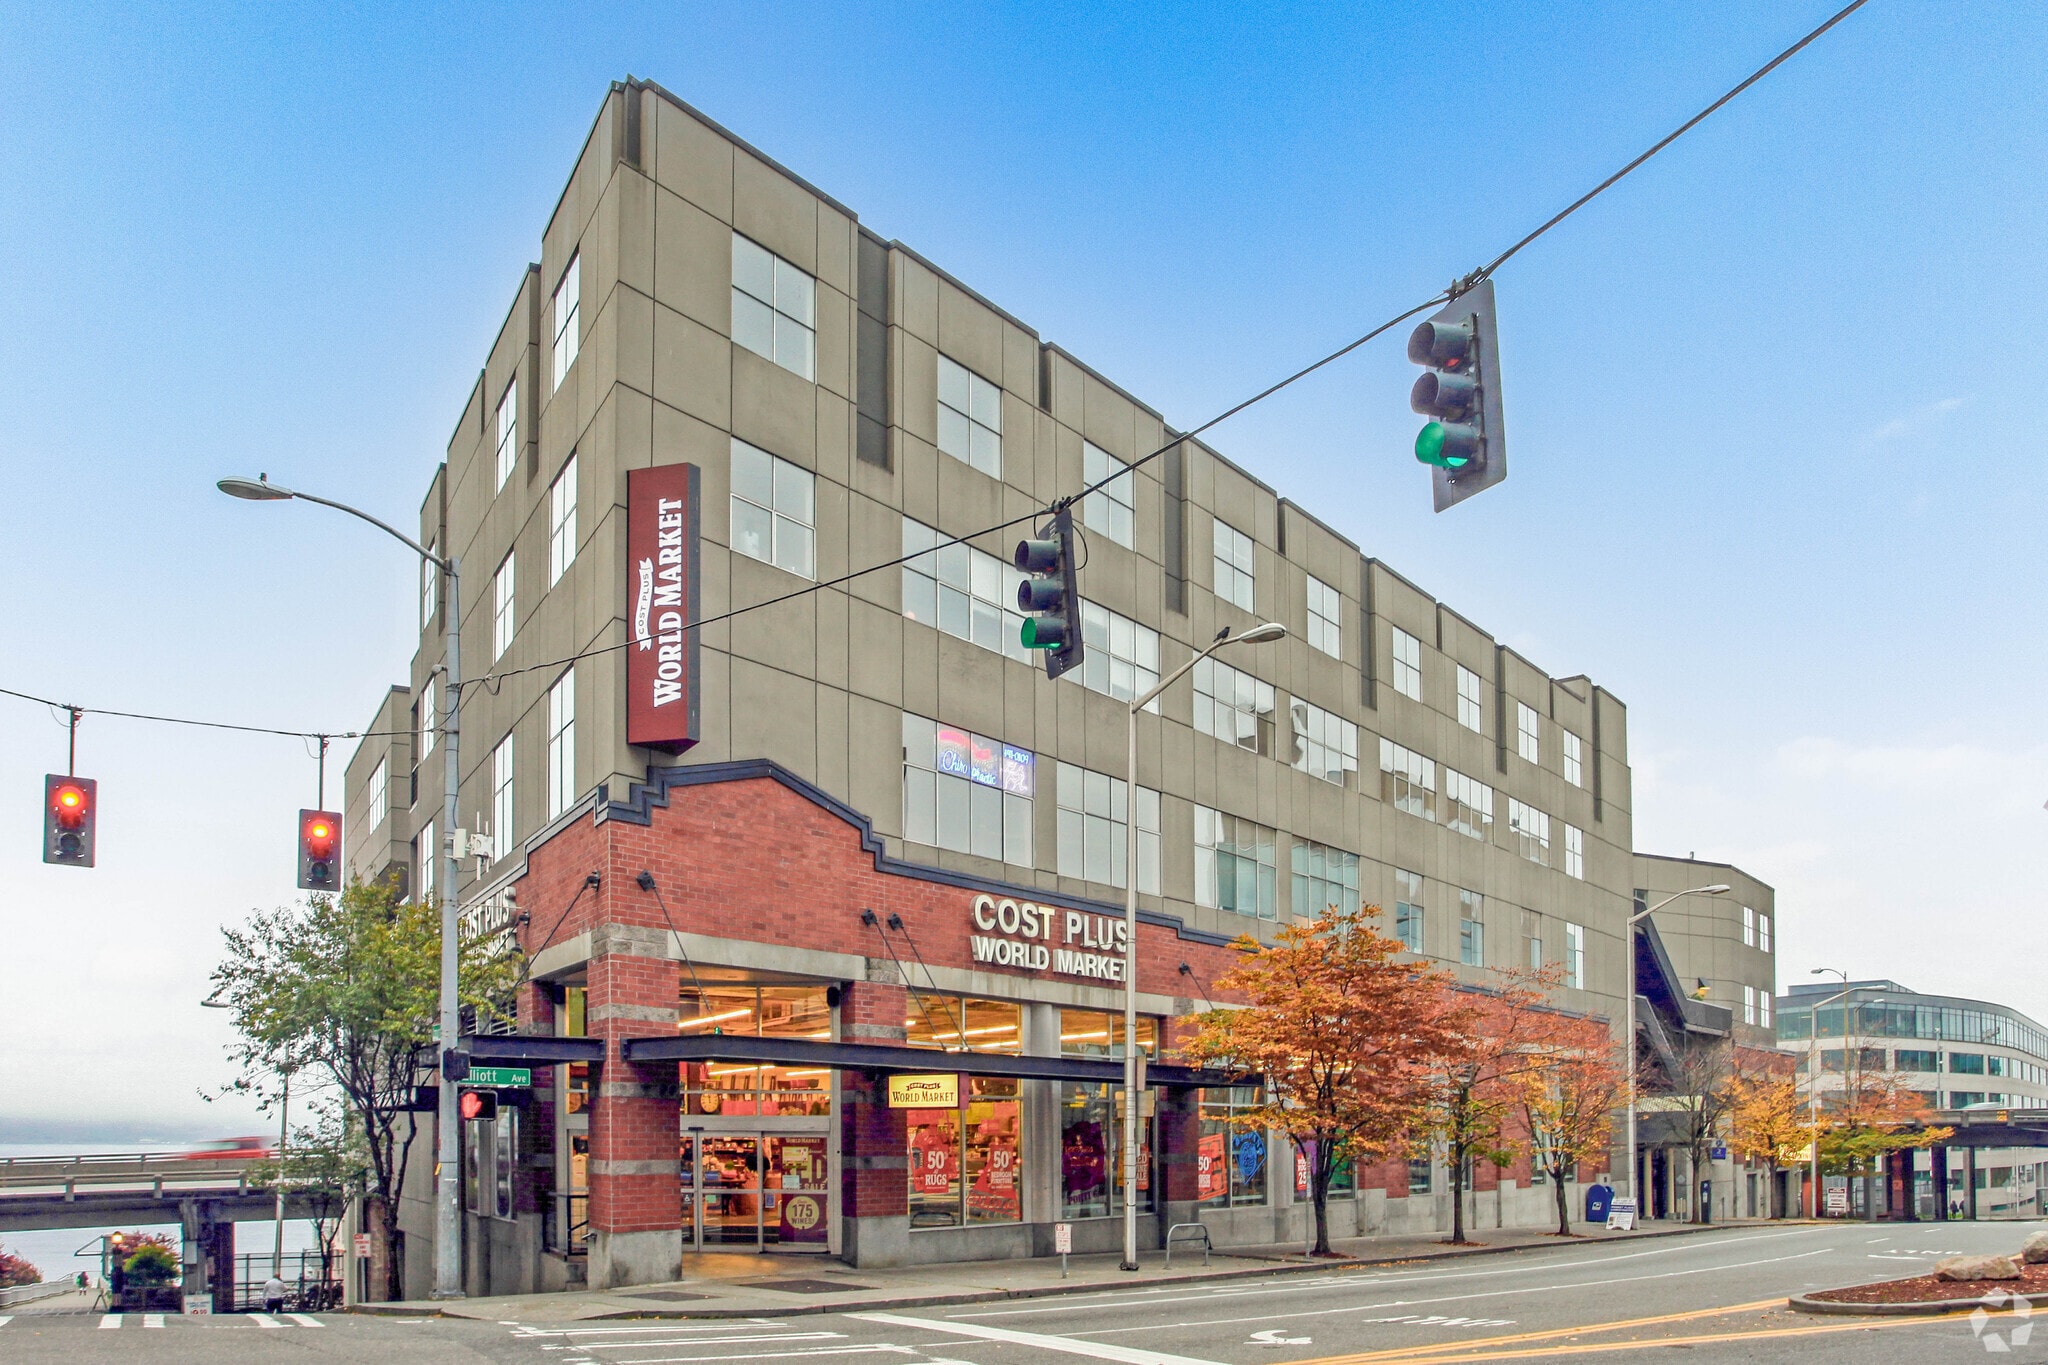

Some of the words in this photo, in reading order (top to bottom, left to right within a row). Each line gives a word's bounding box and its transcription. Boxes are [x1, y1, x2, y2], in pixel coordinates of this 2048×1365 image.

[654, 498, 682, 607] MARKET
[642, 572, 651, 602] PLUS
[638, 604, 647, 635] COST
[653, 611, 682, 708] WORLD
[971, 894, 1055, 940] COST
[1062, 911, 1127, 953] PLUS
[970, 935, 1050, 970] WORLD
[462, 1070, 497, 1082] lliott
[511, 1074, 527, 1083] Ave
[892, 1091, 920, 1102] WORLD
[921, 1091, 955, 1102] MARKET
[925, 1174, 947, 1186] RUGS
[792, 1203, 813, 1217] 175
